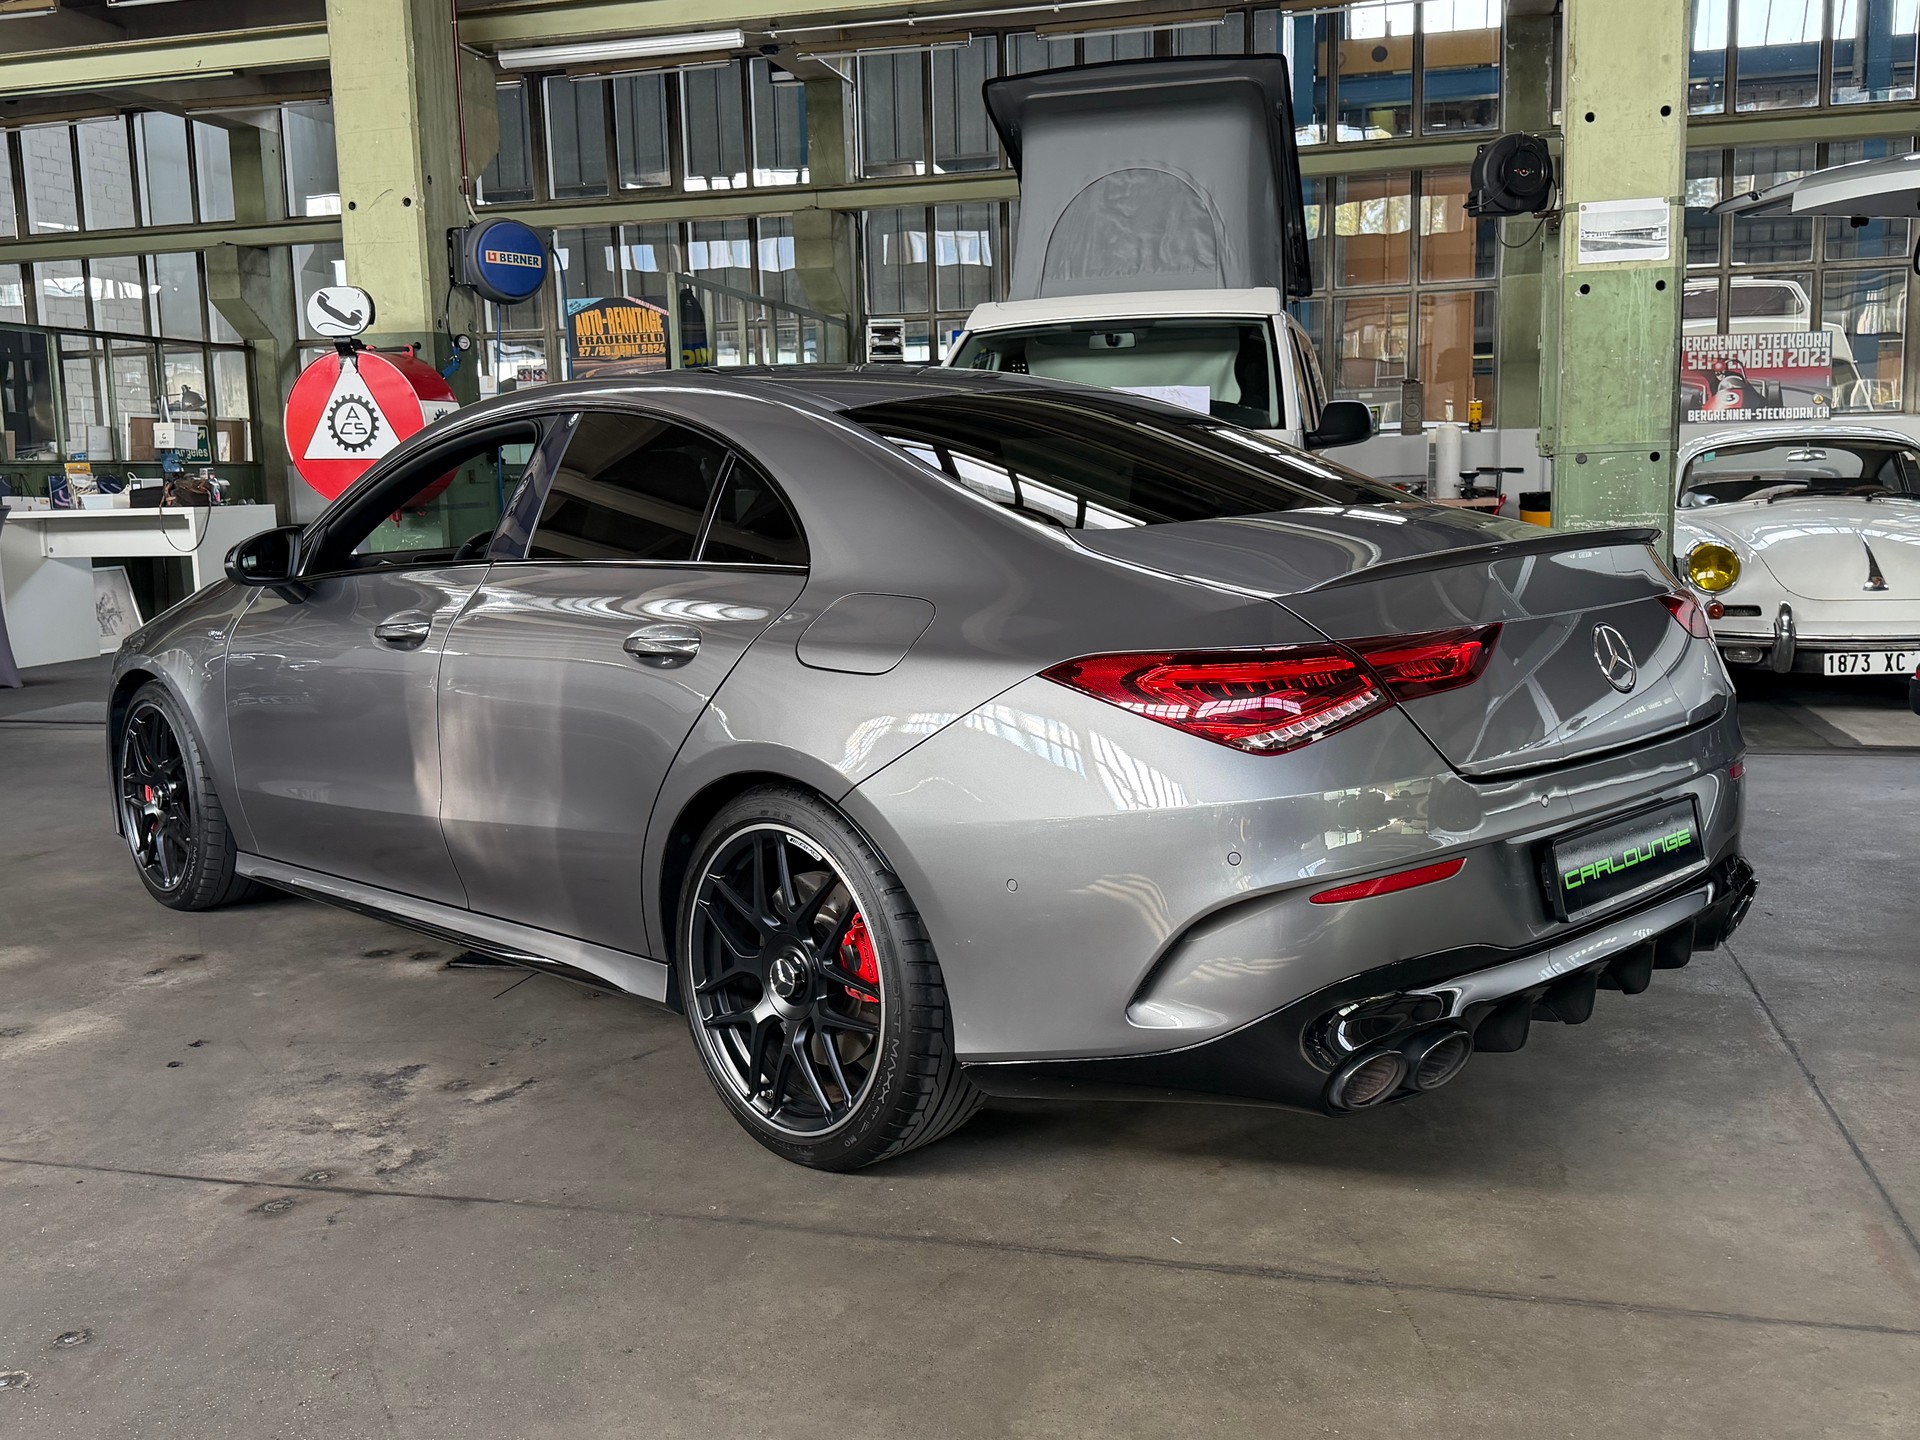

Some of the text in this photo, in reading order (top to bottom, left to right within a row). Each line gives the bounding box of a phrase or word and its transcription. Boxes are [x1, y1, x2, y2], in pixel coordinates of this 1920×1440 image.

[500, 253, 539, 266] BERNER
[576, 307, 664, 335] AUTO-RENNTAGE
[578, 333, 664, 346] FRAUENFELD
[641, 343, 666, 354] 2024
[1759, 332, 1831, 349] STECKBORN
[1787, 347, 1831, 368] 2023
[1688, 406, 1830, 422] BERGRENNEN-STECKBORN.CH
[1828, 652, 1906, 674] 1873 XC
[1564, 828, 1691, 890] CARLOUNGE
[878, 1038, 900, 1104] MAXX
